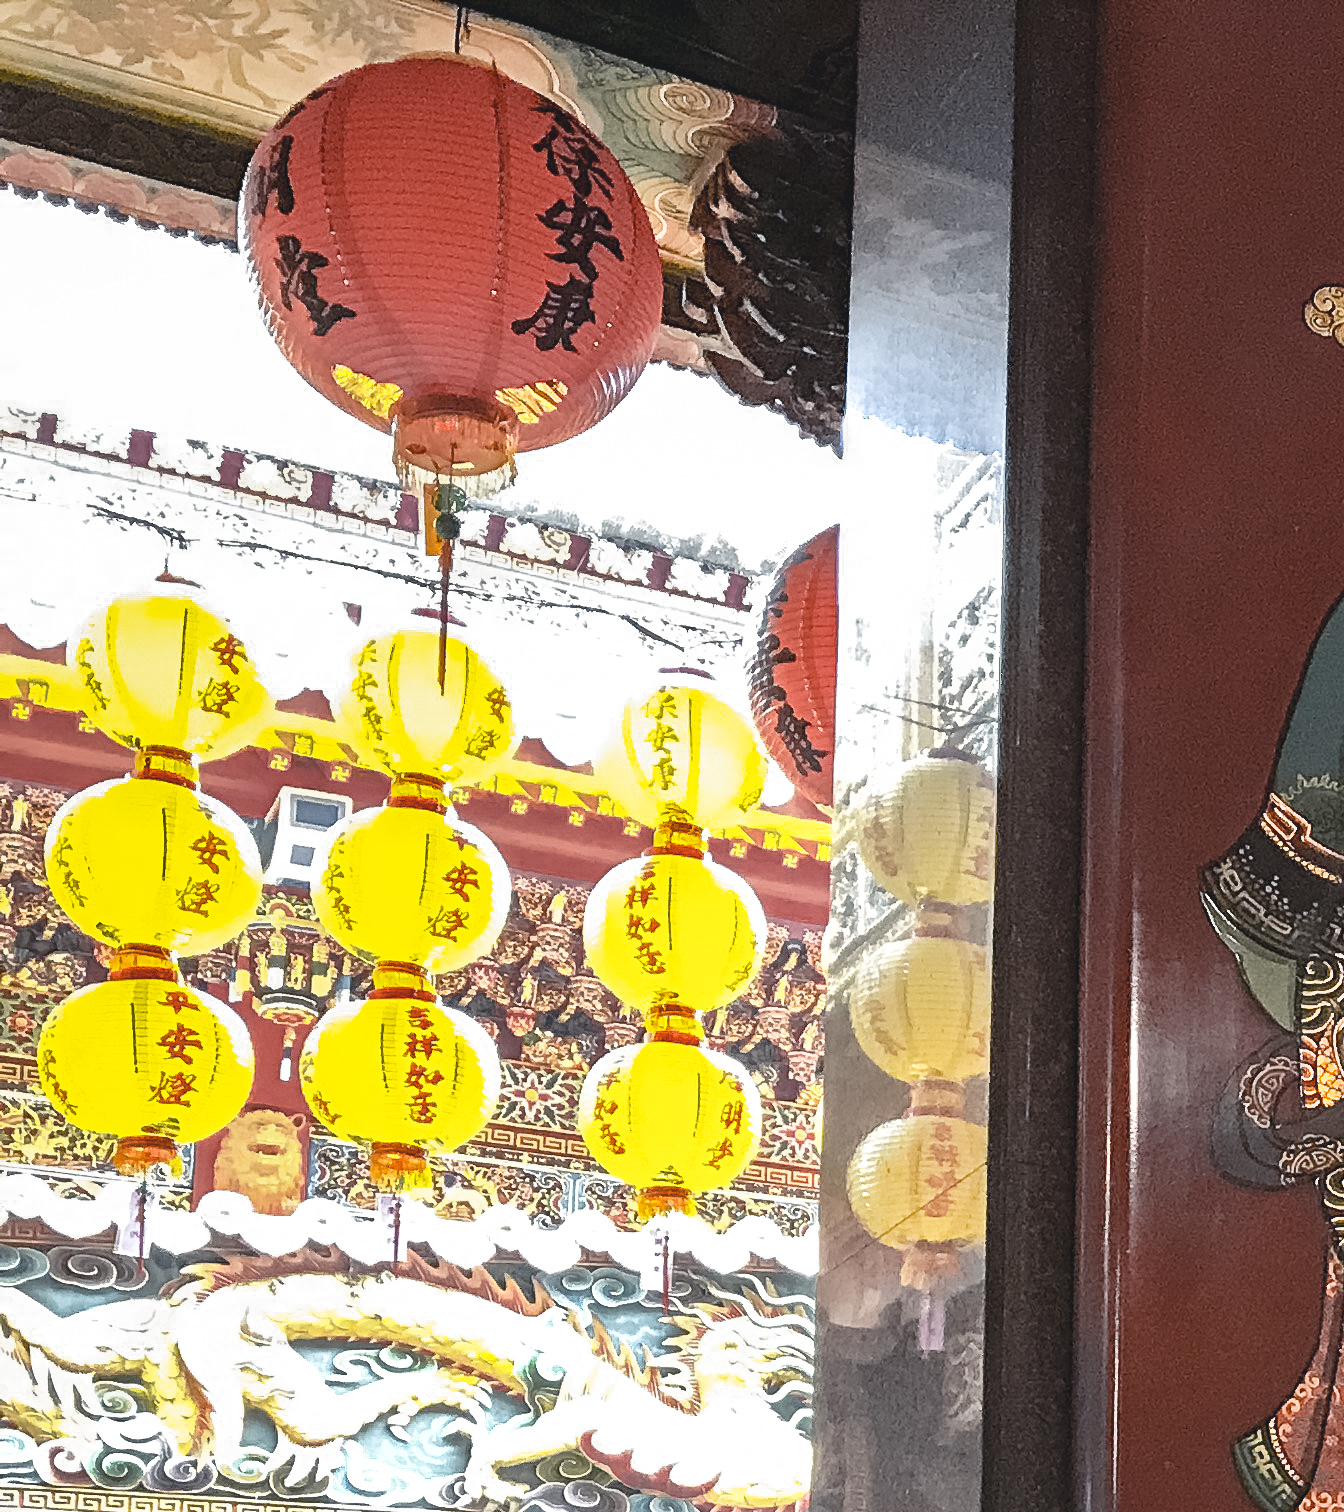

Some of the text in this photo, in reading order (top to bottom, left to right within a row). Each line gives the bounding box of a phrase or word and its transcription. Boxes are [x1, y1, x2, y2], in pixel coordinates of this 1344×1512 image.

[148, 990, 204, 1108] 平安燈
[403, 1005, 445, 1124] 吉祥如意
